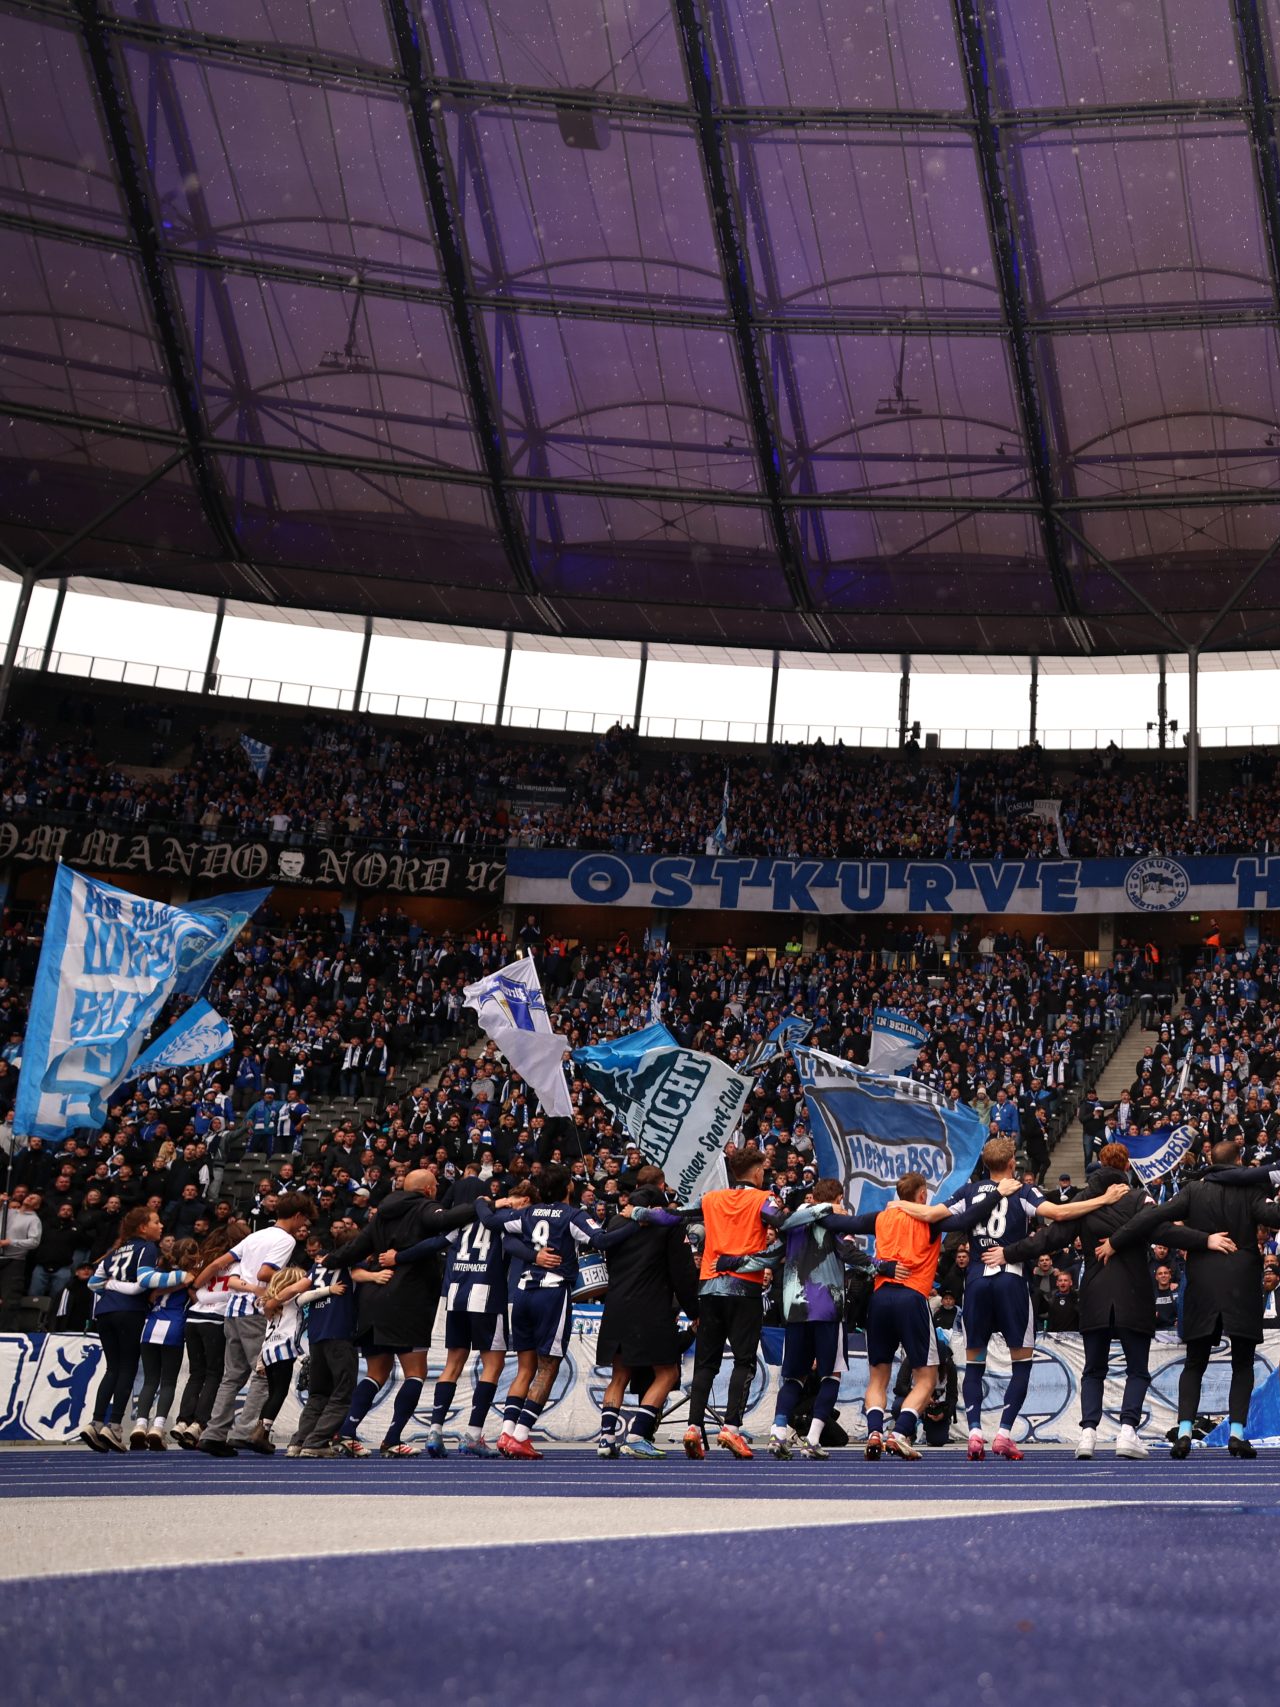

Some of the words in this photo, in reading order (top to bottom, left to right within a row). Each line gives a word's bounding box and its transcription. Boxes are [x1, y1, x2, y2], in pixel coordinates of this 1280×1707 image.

[315, 846, 452, 893] NORD
[568, 853, 1081, 913] OSTKURVE
[1131, 860, 1183, 880] OSTKURVE
[1129, 891, 1167, 910] HERTHA
[1168, 891, 1185, 907] BSC
[876, 1016, 888, 1027] IN
[889, 1019, 917, 1036] BERLIN
[637, 1050, 710, 1168] EMACHT
[905, 1146, 945, 1182] BSC
[456, 1221, 492, 1262] 14
[108, 1250, 134, 1282] 37
